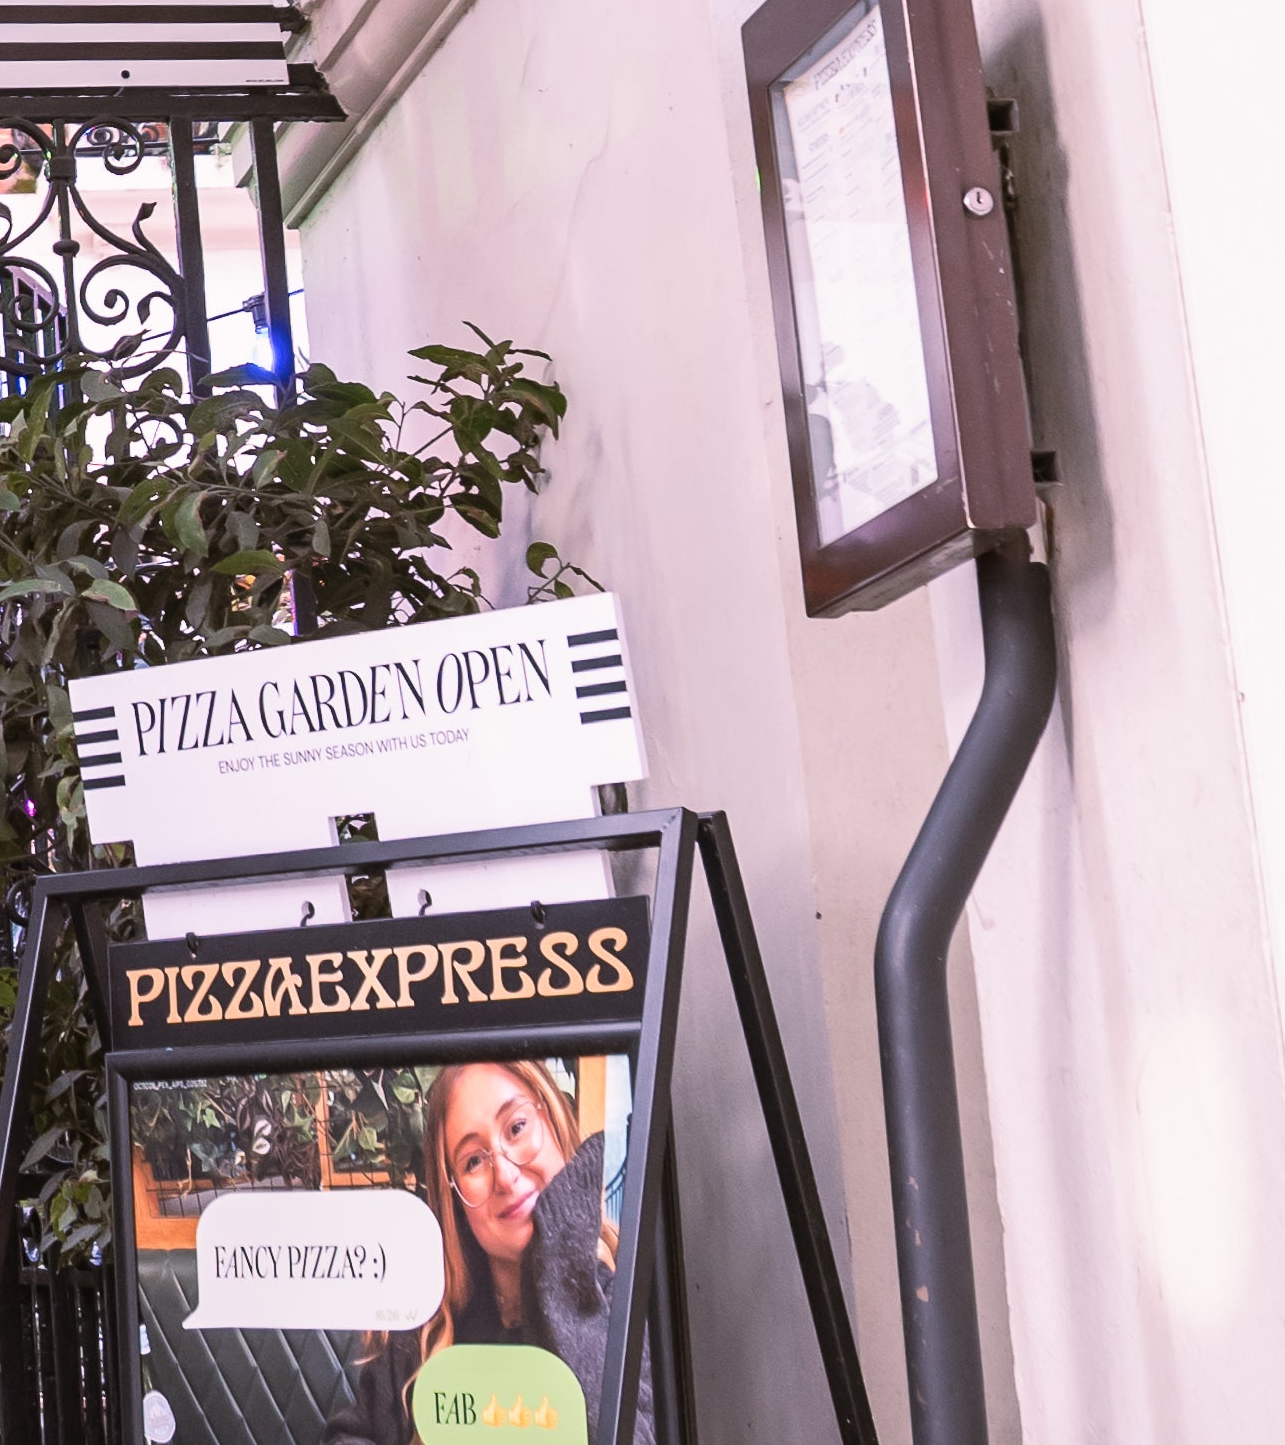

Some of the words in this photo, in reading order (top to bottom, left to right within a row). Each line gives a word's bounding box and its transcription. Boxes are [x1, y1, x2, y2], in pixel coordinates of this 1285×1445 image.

[131, 689, 253, 756] PIZZA
[258, 659, 427, 739] GARDEN
[436, 639, 551, 714] OPEN
[219, 757, 255, 774] ENJOY
[259, 753, 281, 769] THE
[283, 748, 322, 766] SUNNY
[326, 742, 374, 761] SEASON
[376, 737, 407, 754] WITH
[411, 733, 427, 749] US
[429, 728, 469, 746] TODAY
[126, 926, 634, 1026] PIZZAEXPRESS
[214, 1245, 282, 1279] FANCY
[287, 1245, 367, 1279] PIZZA?
[434, 1392, 477, 1426] FAB
